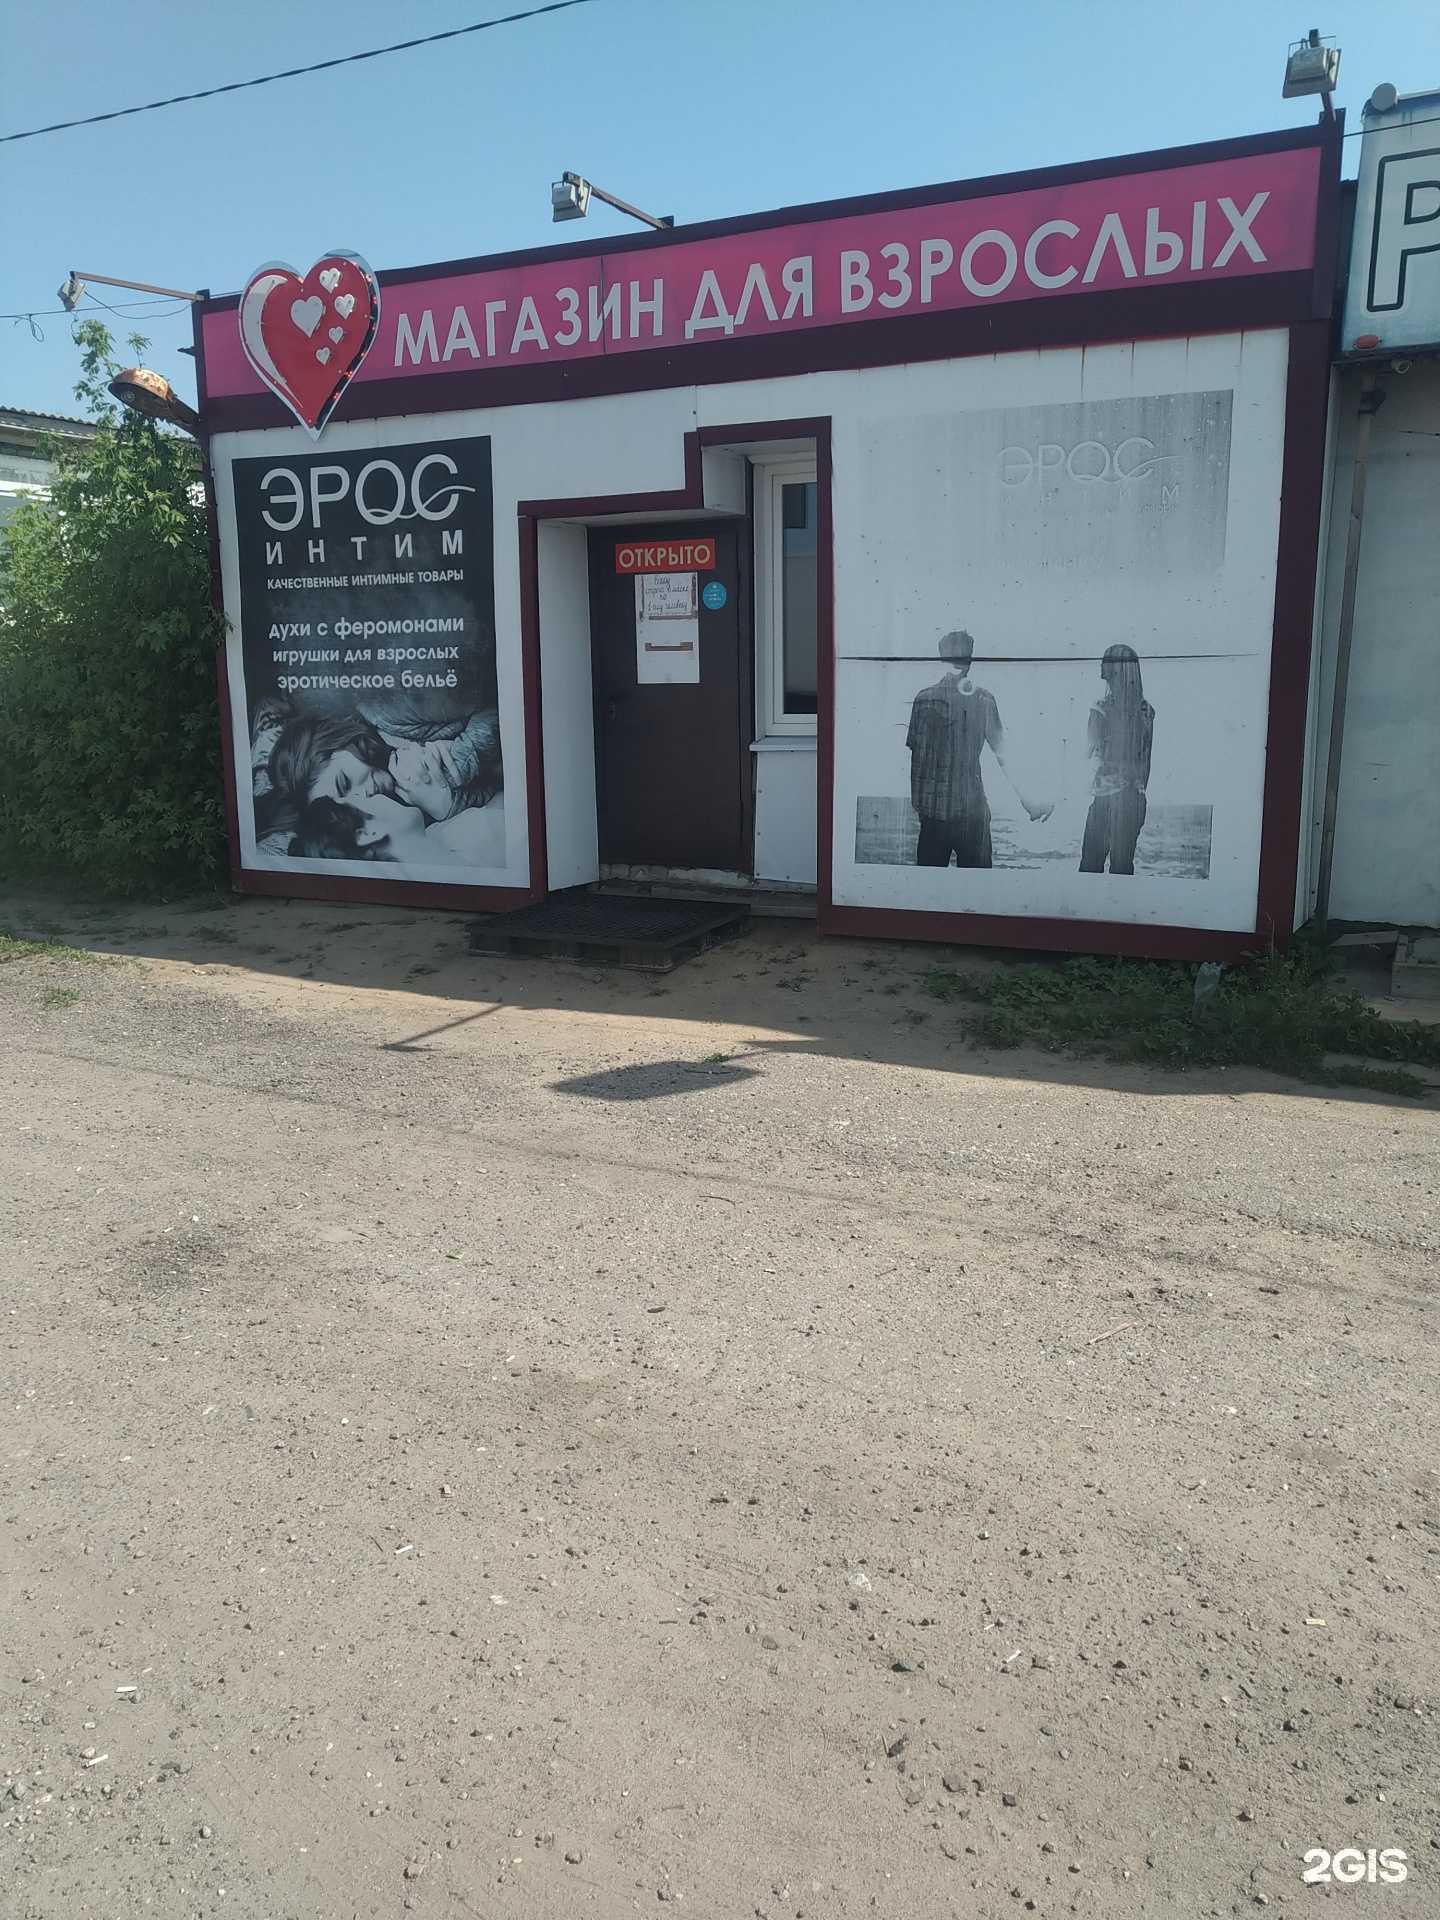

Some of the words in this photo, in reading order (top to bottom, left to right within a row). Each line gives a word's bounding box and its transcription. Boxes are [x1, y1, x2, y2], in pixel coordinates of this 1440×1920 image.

[394, 279, 664, 366] МАГАЗИН
[685, 256, 813, 339] ДЛЯ
[840, 192, 1271, 314] ВЗРОСЛЫХ
[998, 436, 1186, 488] ЭРОС
[260, 453, 476, 532] ЭРОС
[265, 529, 464, 565] ИНТИМ
[618, 544, 711, 568] ОТКРЫТО
[267, 575, 349, 590] КАЧЕСТВЕННЫЕ
[351, 572, 414, 587] ИНТИМНЫЕ
[417, 569, 464, 584] ТОВАРЫ
[268, 622, 311, 642] духи
[316, 623, 328, 636] с
[334, 617, 464, 640] феромонами
[273, 650, 339, 666] игрушки
[344, 649, 371, 664] для
[376, 646, 459, 665] взрослых
[277, 673, 395, 694] эротическое
[400, 668, 458, 689] бельё
